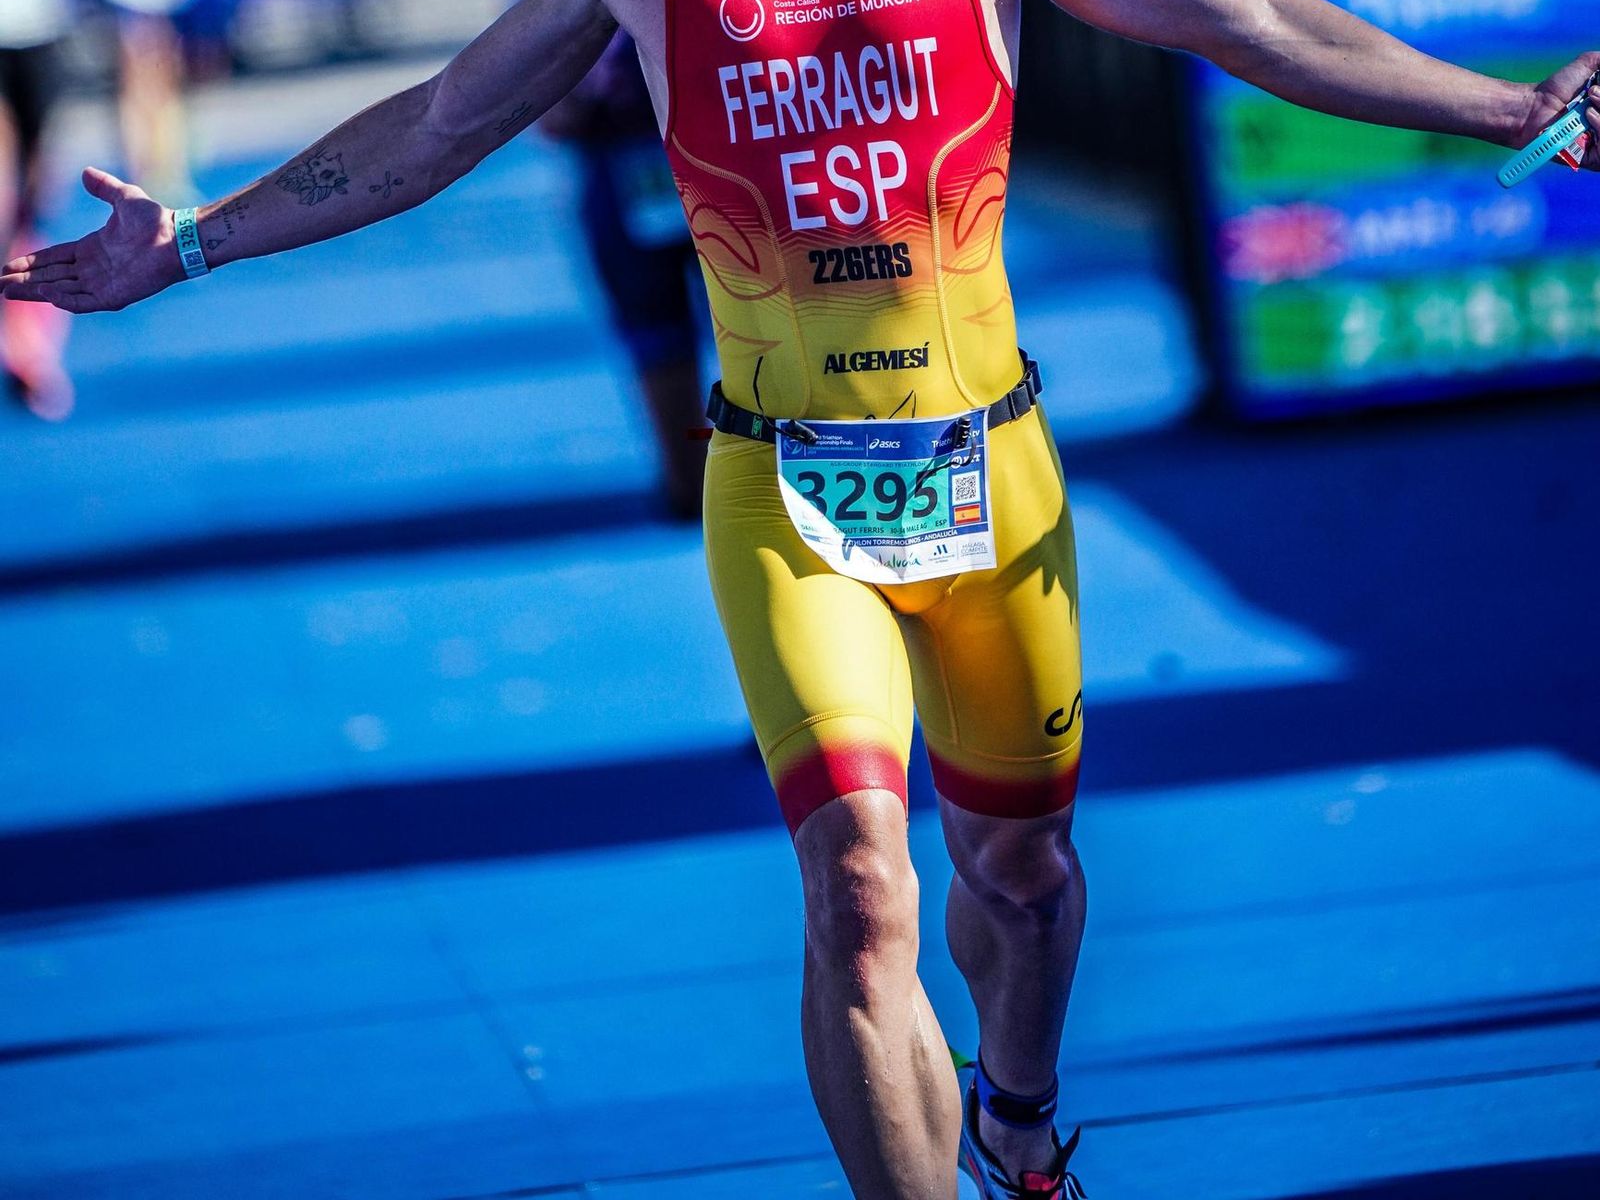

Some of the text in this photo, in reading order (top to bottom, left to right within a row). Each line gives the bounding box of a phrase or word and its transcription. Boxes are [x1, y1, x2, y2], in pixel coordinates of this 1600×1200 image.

[773, 0, 796, 8] Costa
[775, 6, 834, 25] REGIÓN
[837, 1, 857, 18] DE
[718, 37, 940, 144] FERRAGUT
[780, 140, 908, 231] ESP
[179, 218, 196, 248] 3295
[808, 242, 913, 285] 226ERS
[824, 341, 930, 375] ALGEMESÍ
[879, 440, 901, 449] asics
[797, 471, 938, 522] 3295
[872, 536, 921, 546] TORREMOLINOS
[924, 527, 959, 541] ANDALUCÍA
[906, 524, 920, 533] MALE
[920, 522, 929, 530] AG
[935, 519, 948, 527] ESP
